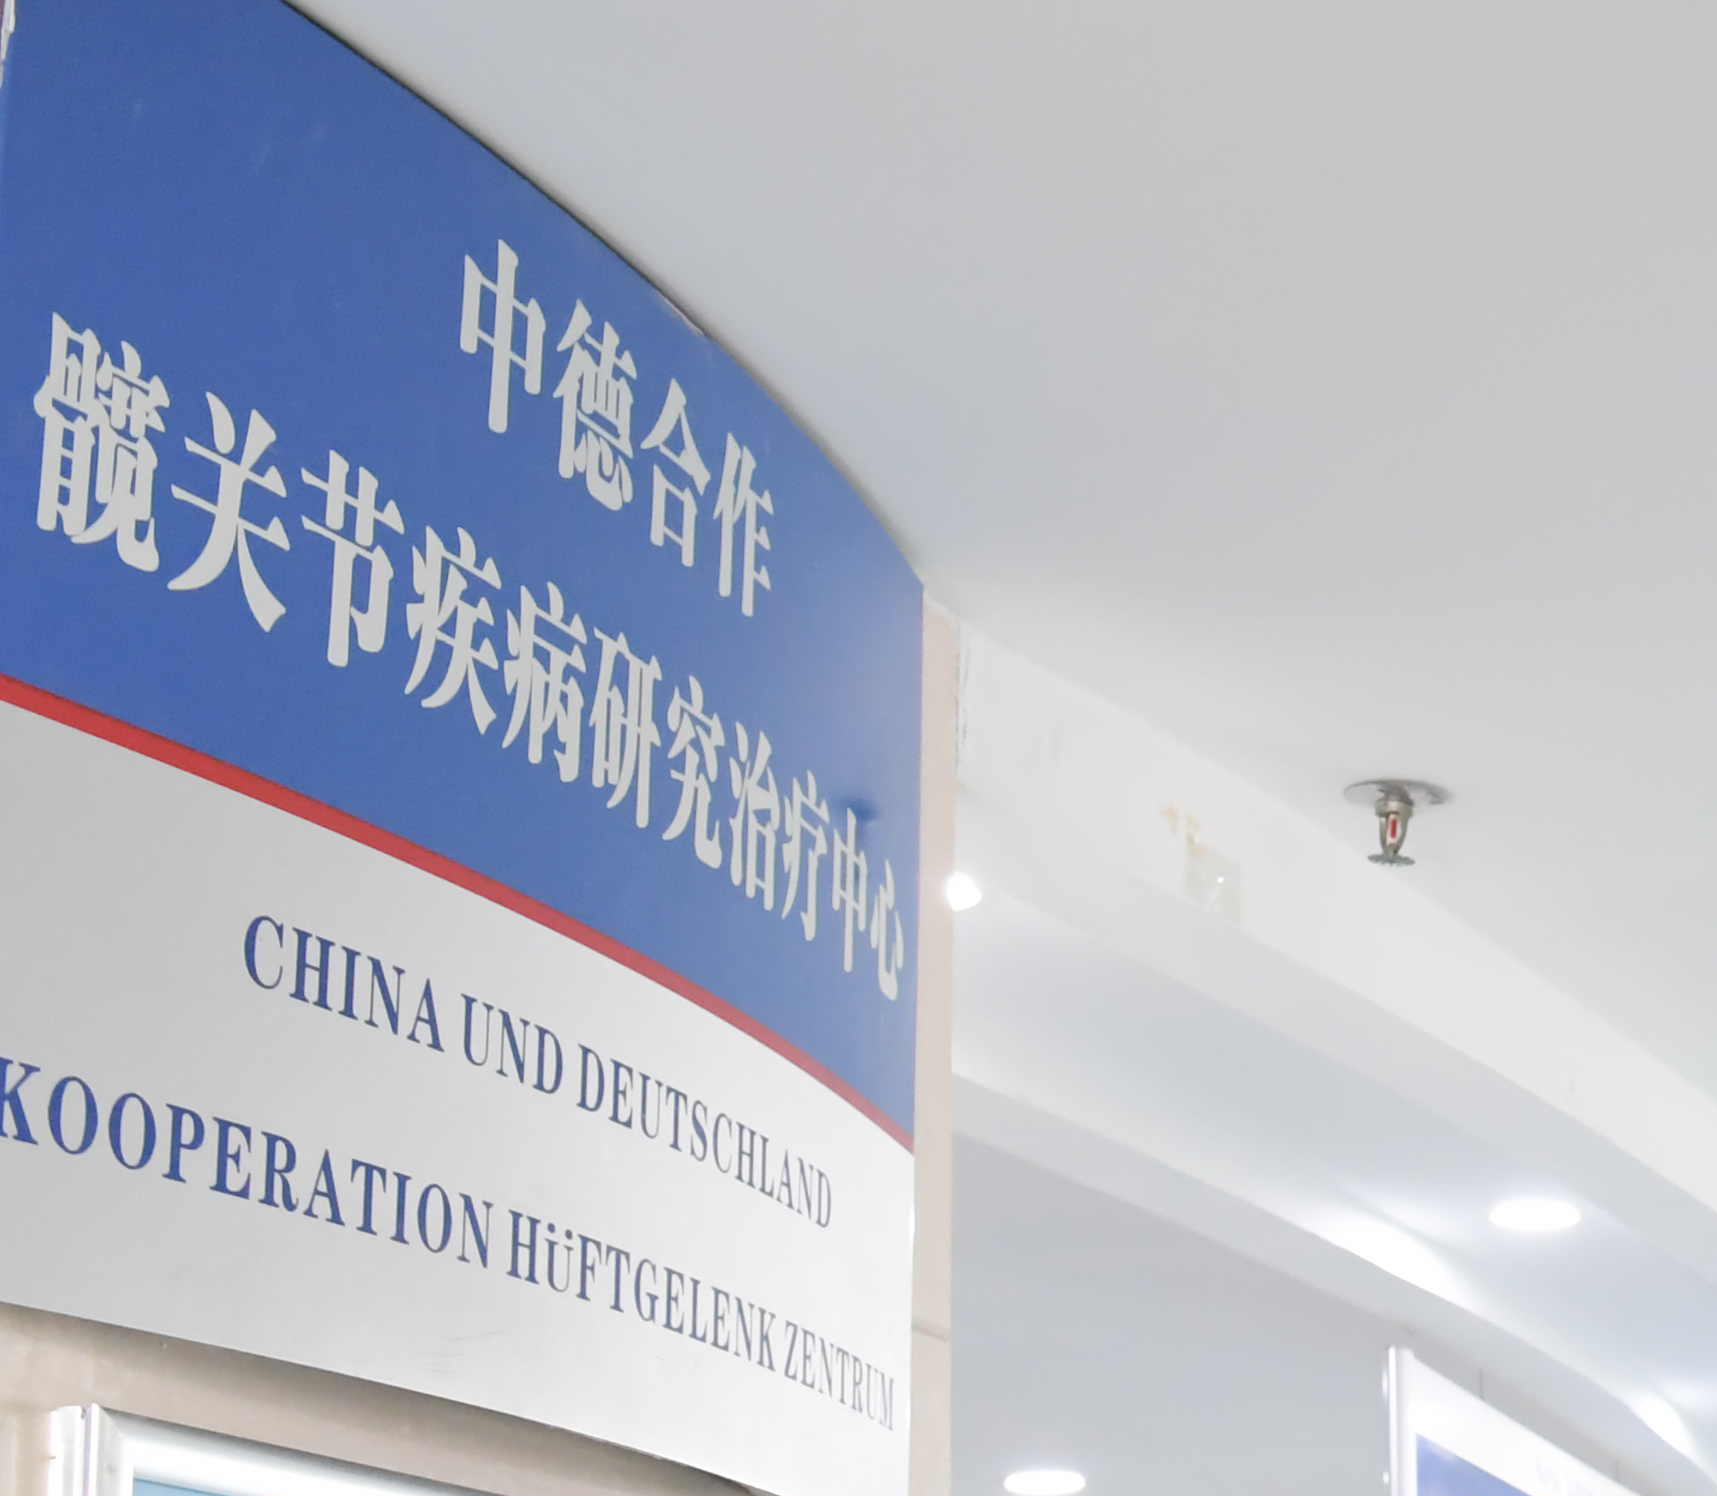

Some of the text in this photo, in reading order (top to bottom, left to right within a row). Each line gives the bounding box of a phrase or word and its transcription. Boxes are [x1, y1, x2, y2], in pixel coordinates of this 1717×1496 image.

[460, 239, 774, 616] 中德合作
[33, 312, 905, 1001] 髋关节疾病研究治疗中心
[0, 1056, 493, 1269] KOOPERATION
[784, 1319, 894, 1431] ZENTRUM
[243, 915, 832, 1228] CHINA UND DEUTSCHLAND
